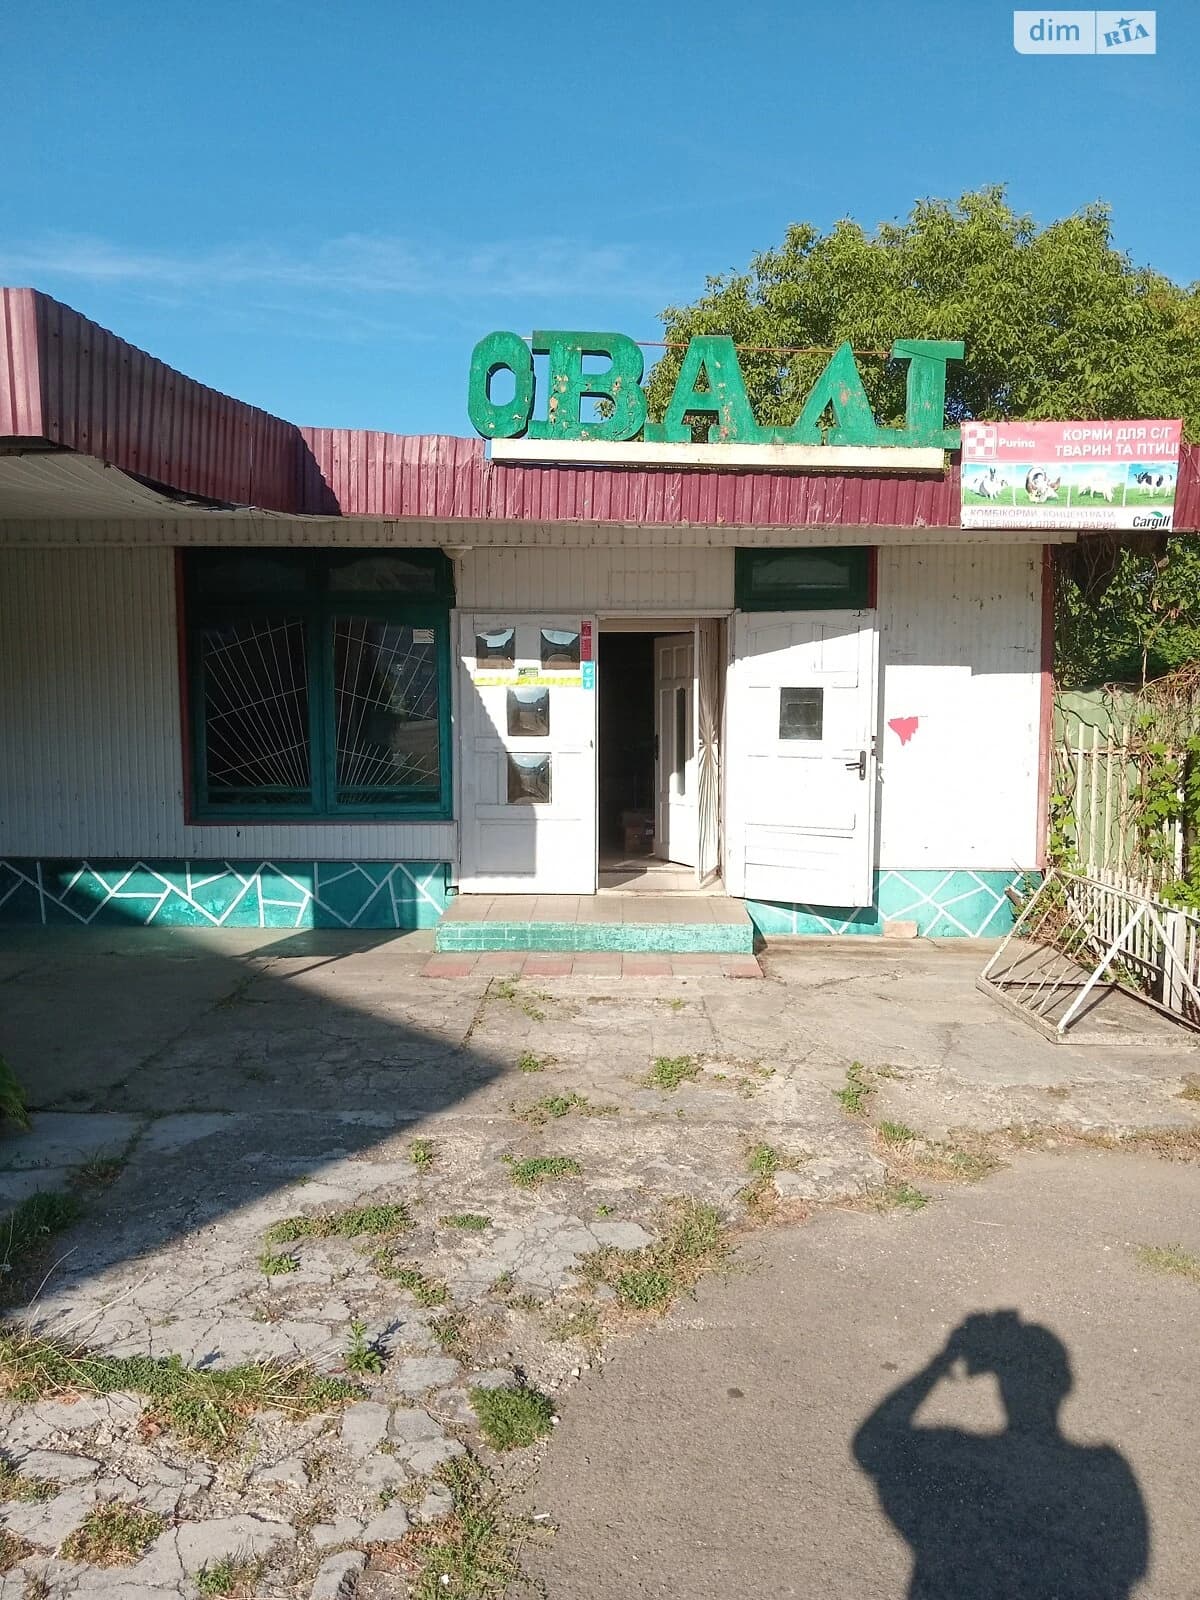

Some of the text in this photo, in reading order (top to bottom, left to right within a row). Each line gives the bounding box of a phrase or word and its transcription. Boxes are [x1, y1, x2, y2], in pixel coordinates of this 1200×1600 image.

[1063, 426, 1173, 443] КОРМИ ДЛЯ С/Г
[999, 438, 1036, 449] Purina
[1055, 443, 1112, 457] ТВАРИН
[1115, 443, 1133, 456] ТА
[1132, 515, 1171, 529] Cargill
